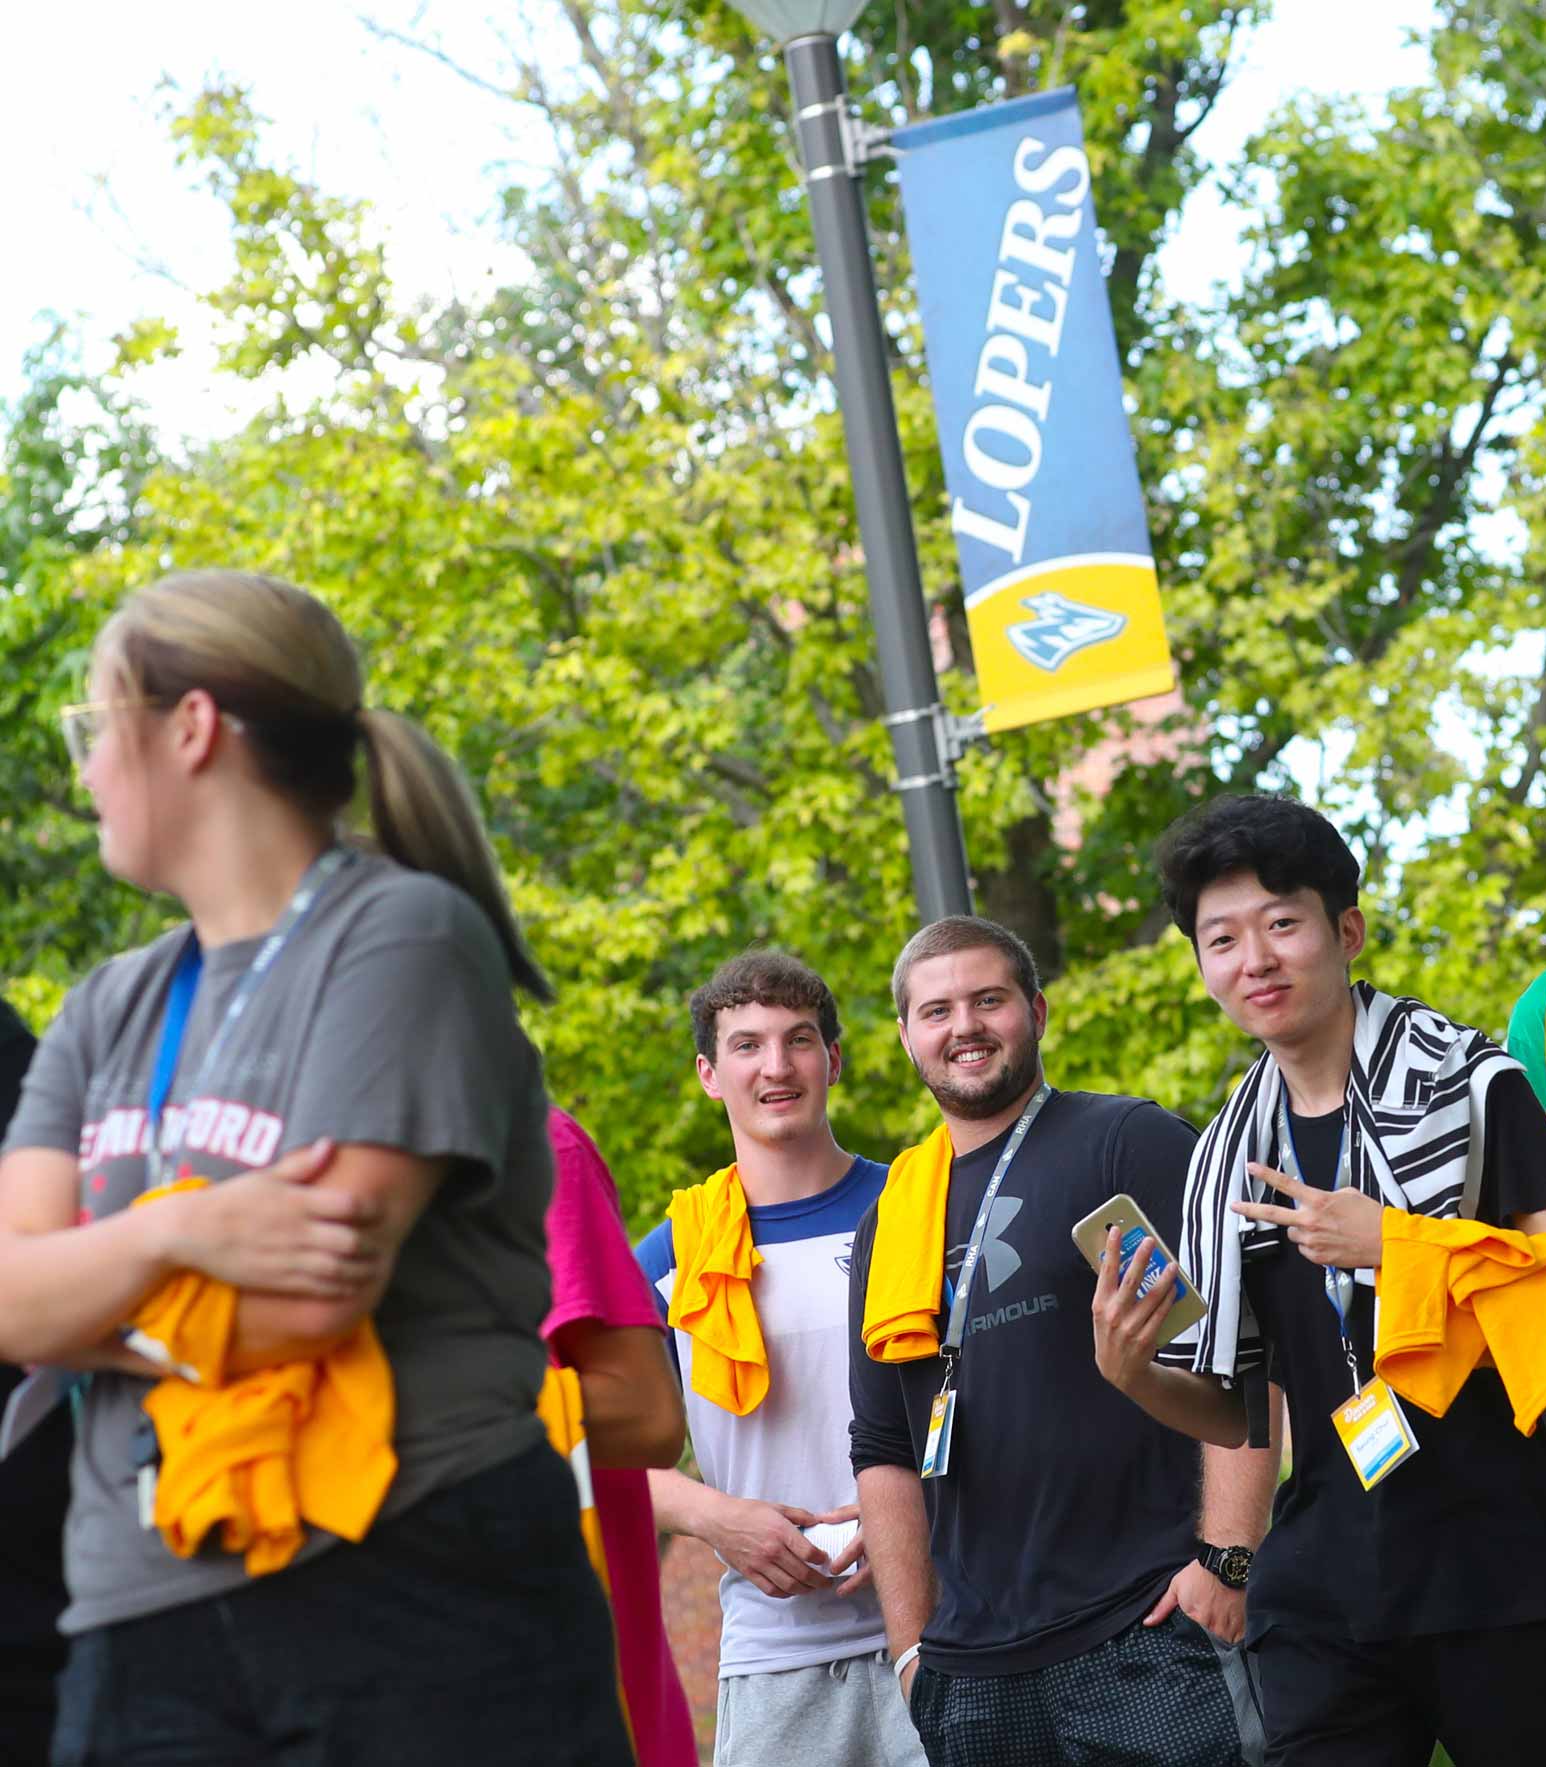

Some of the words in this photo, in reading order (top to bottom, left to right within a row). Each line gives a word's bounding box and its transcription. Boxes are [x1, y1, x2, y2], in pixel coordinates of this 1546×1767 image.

[952, 136, 1091, 564] LOPERS
[1015, 1115, 1032, 1135] RHA
[965, 1244, 979, 1267] RHA
[965, 1294, 1058, 1336] RMOUR
